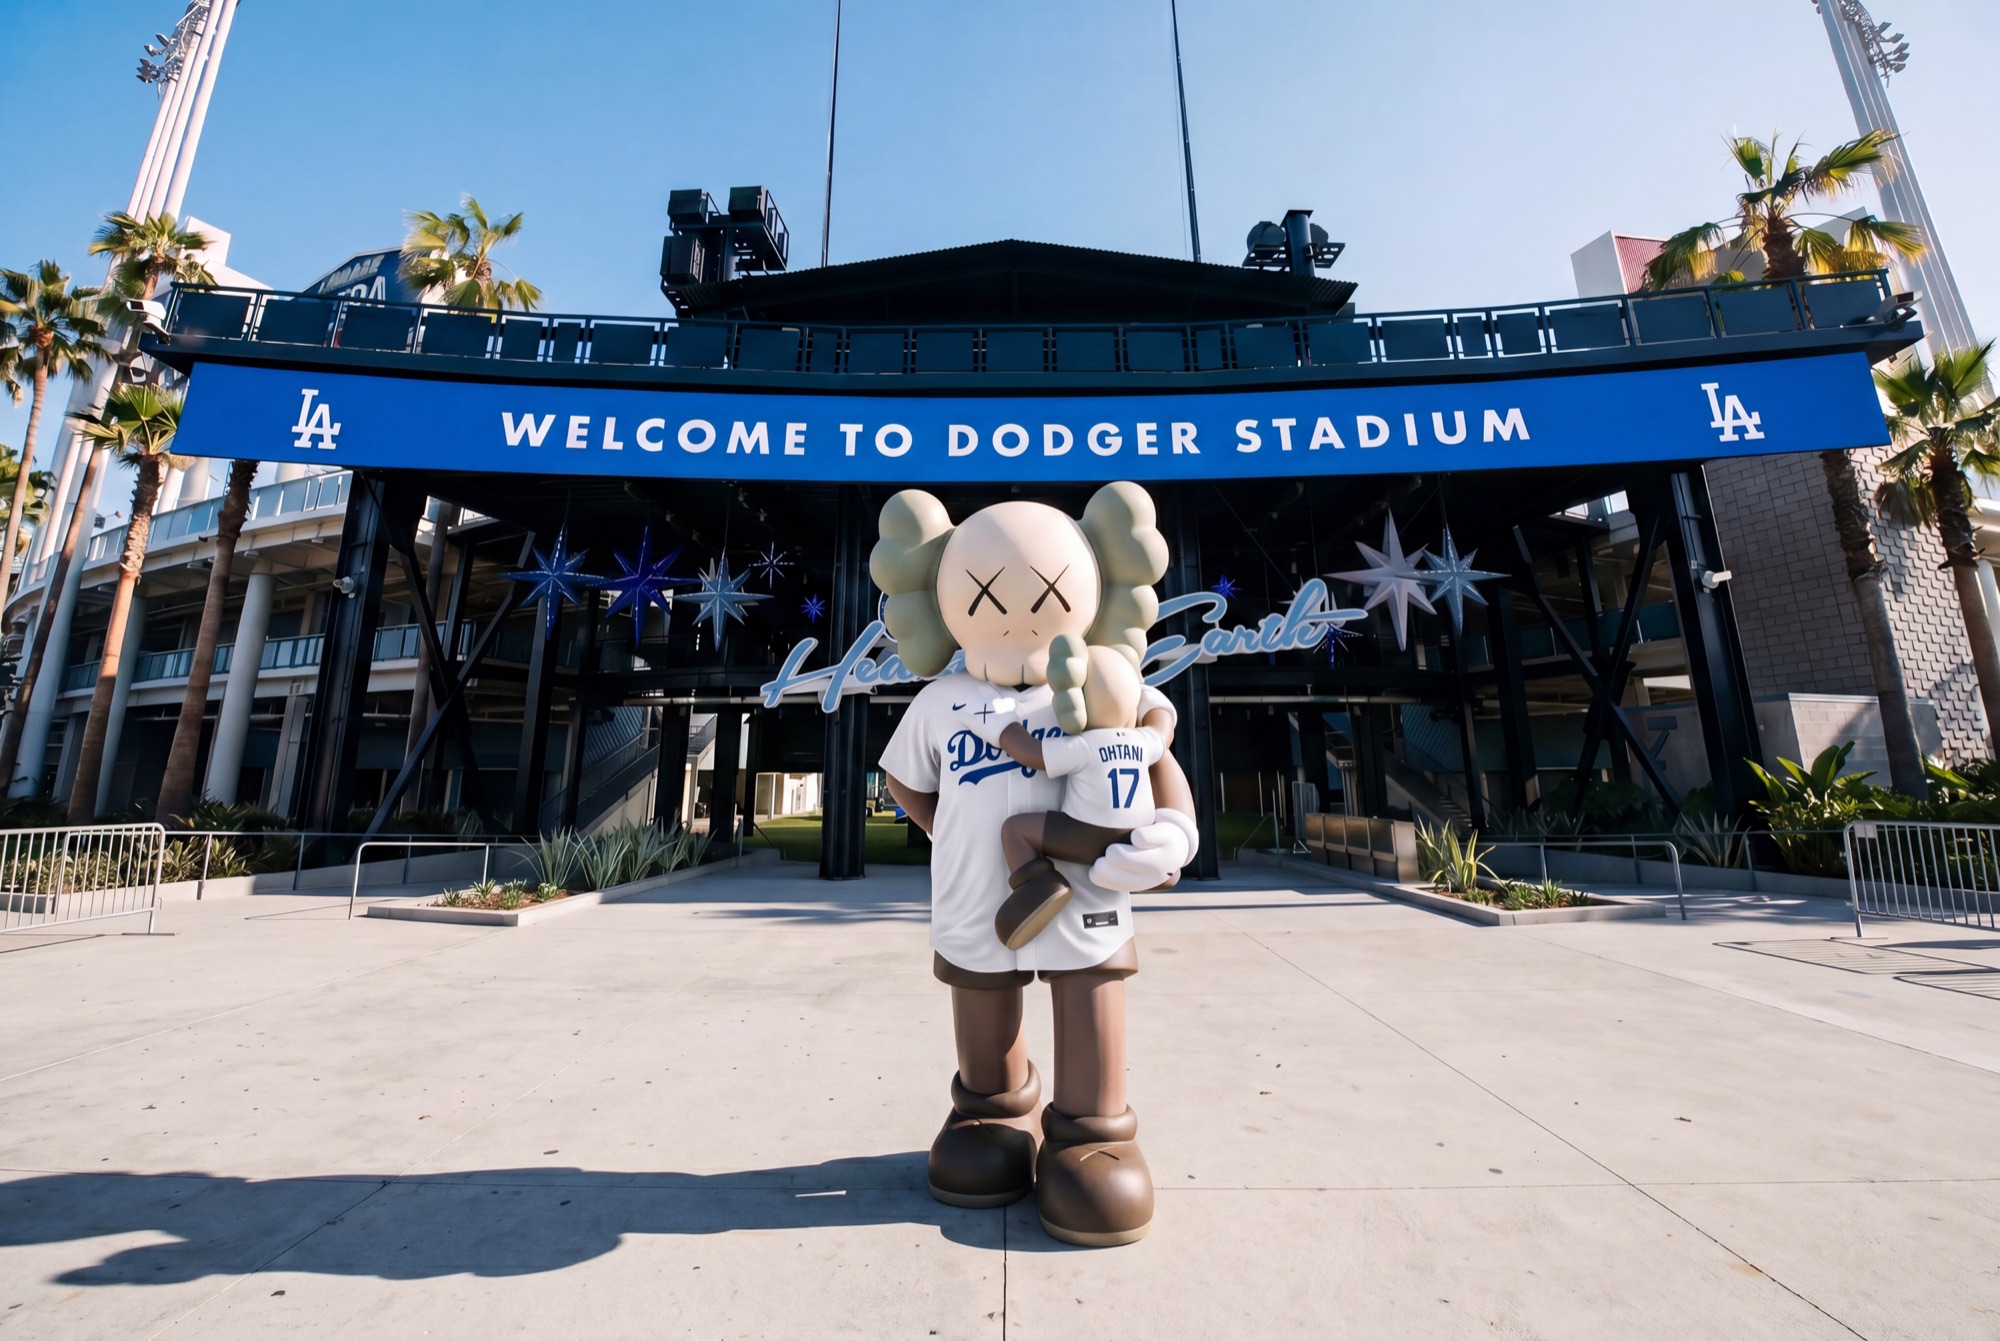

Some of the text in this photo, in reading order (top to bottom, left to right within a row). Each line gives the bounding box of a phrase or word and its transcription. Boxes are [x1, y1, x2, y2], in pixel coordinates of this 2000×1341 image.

[291, 388, 342, 450] LA
[501, 407, 1531, 458] WELCOME TO DODGER STADIUM
[1700, 382, 1765, 442] LA
[1098, 743, 1143, 763] OHTANI
[1107, 767, 1140, 809] 17
